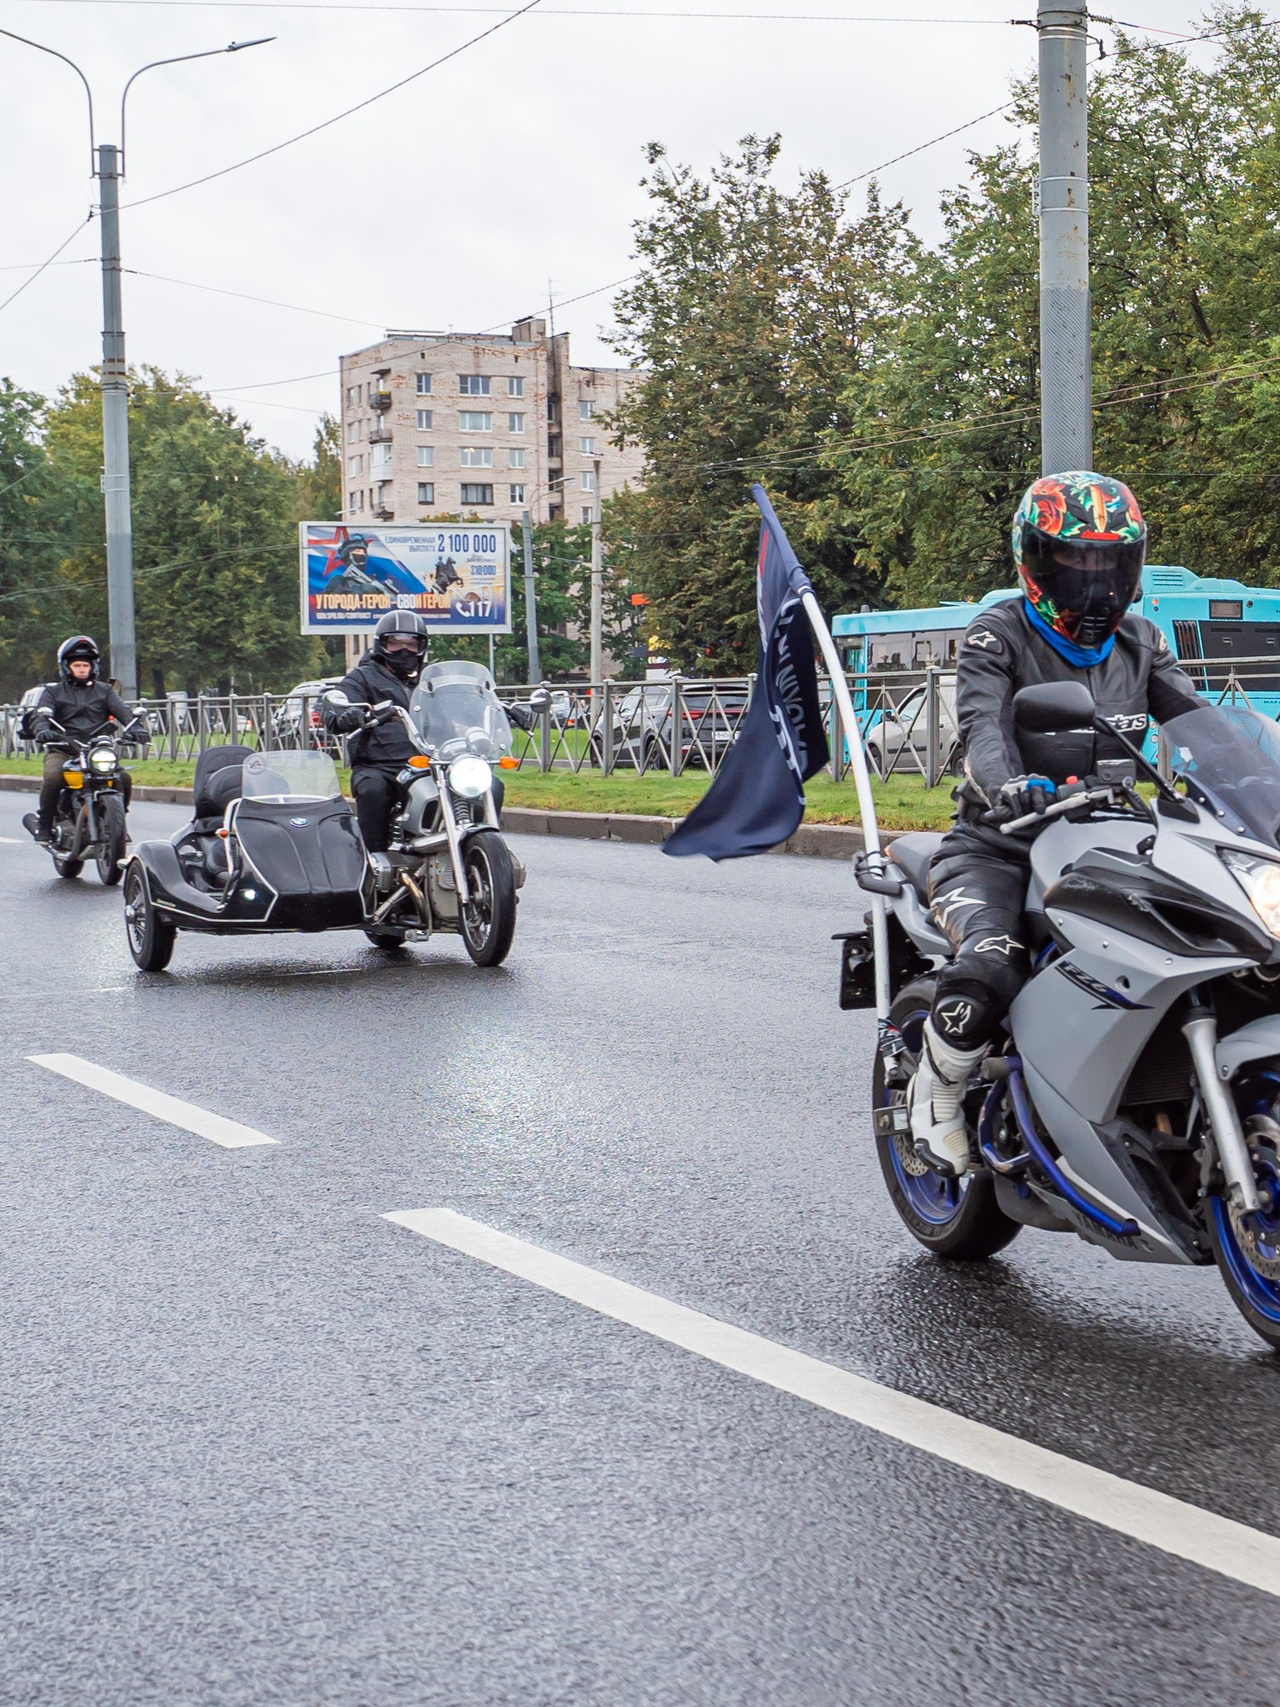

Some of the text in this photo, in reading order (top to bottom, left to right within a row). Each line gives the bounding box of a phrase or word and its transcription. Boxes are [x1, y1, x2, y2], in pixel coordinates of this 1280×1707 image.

[438, 534, 496, 553] 2 100 000
[315, 593, 322, 609] У
[469, 601, 492, 617] 117
